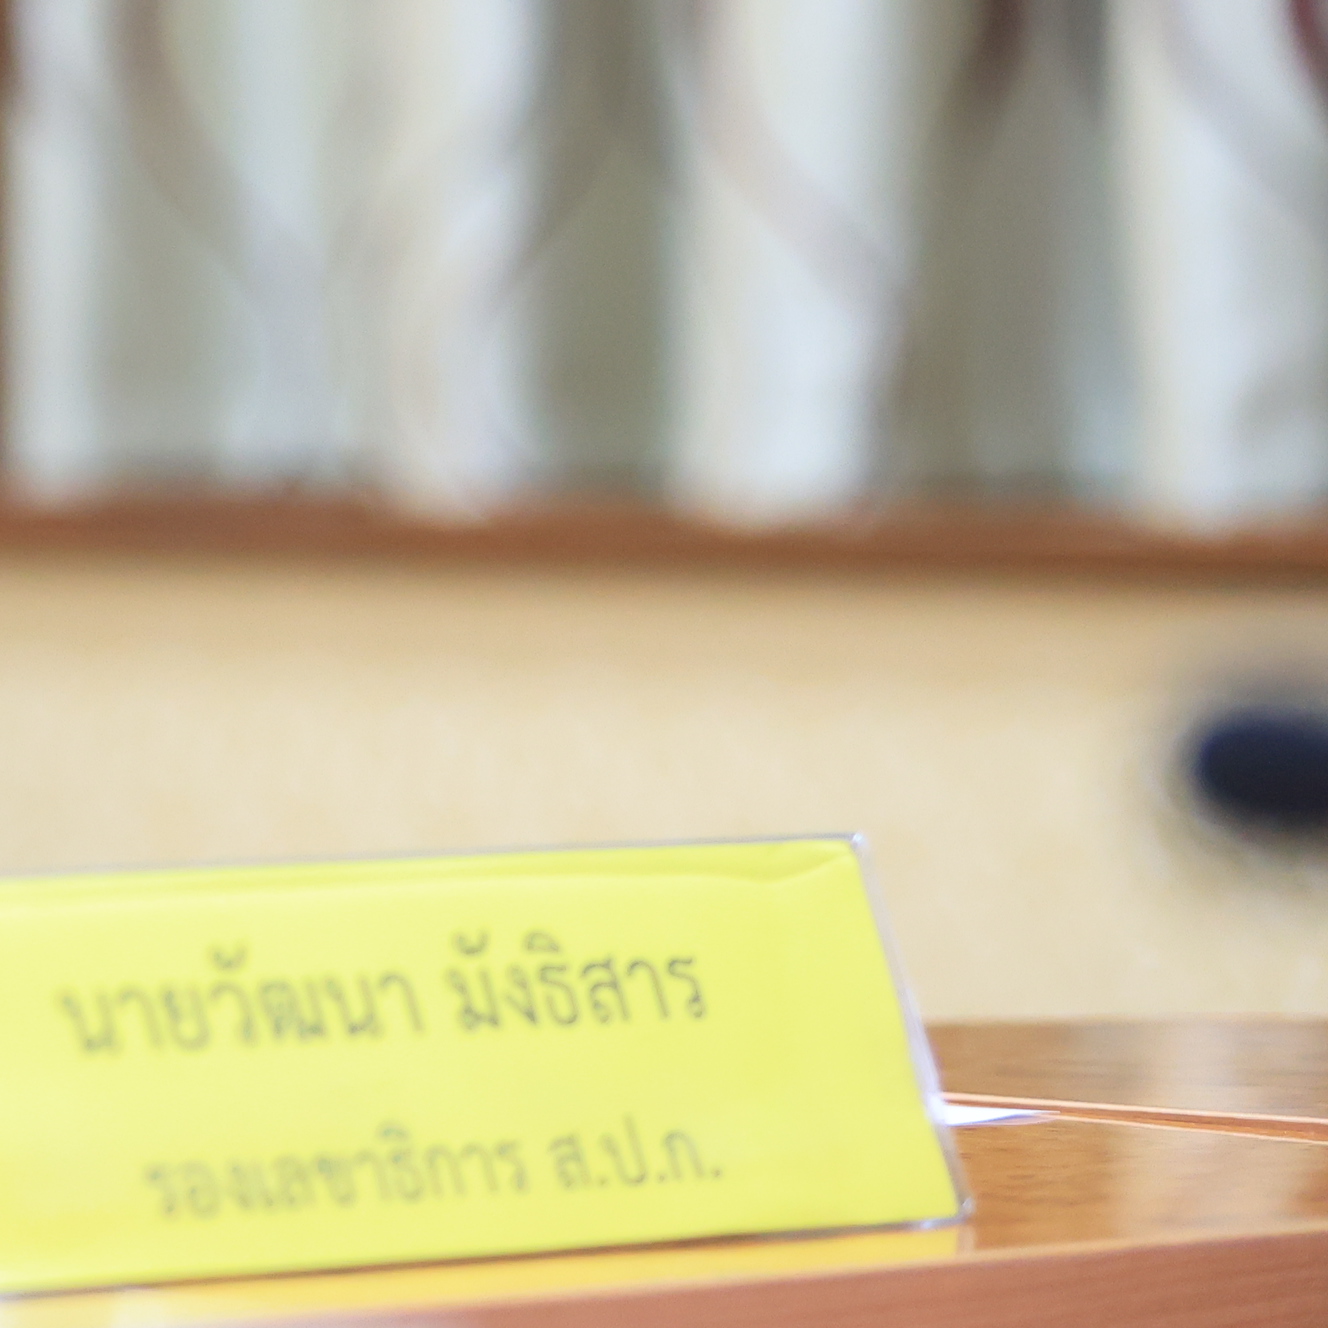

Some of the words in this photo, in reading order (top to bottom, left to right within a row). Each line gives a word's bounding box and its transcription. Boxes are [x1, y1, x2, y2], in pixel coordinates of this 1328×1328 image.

[58, 944, 426, 1054] นายวัฒนา
[444, 930, 708, 1031] มังธิสาร
[144, 1120, 532, 1218] รองเลขาธิการ
[548, 1116, 724, 1190] ส.ป.ก.
